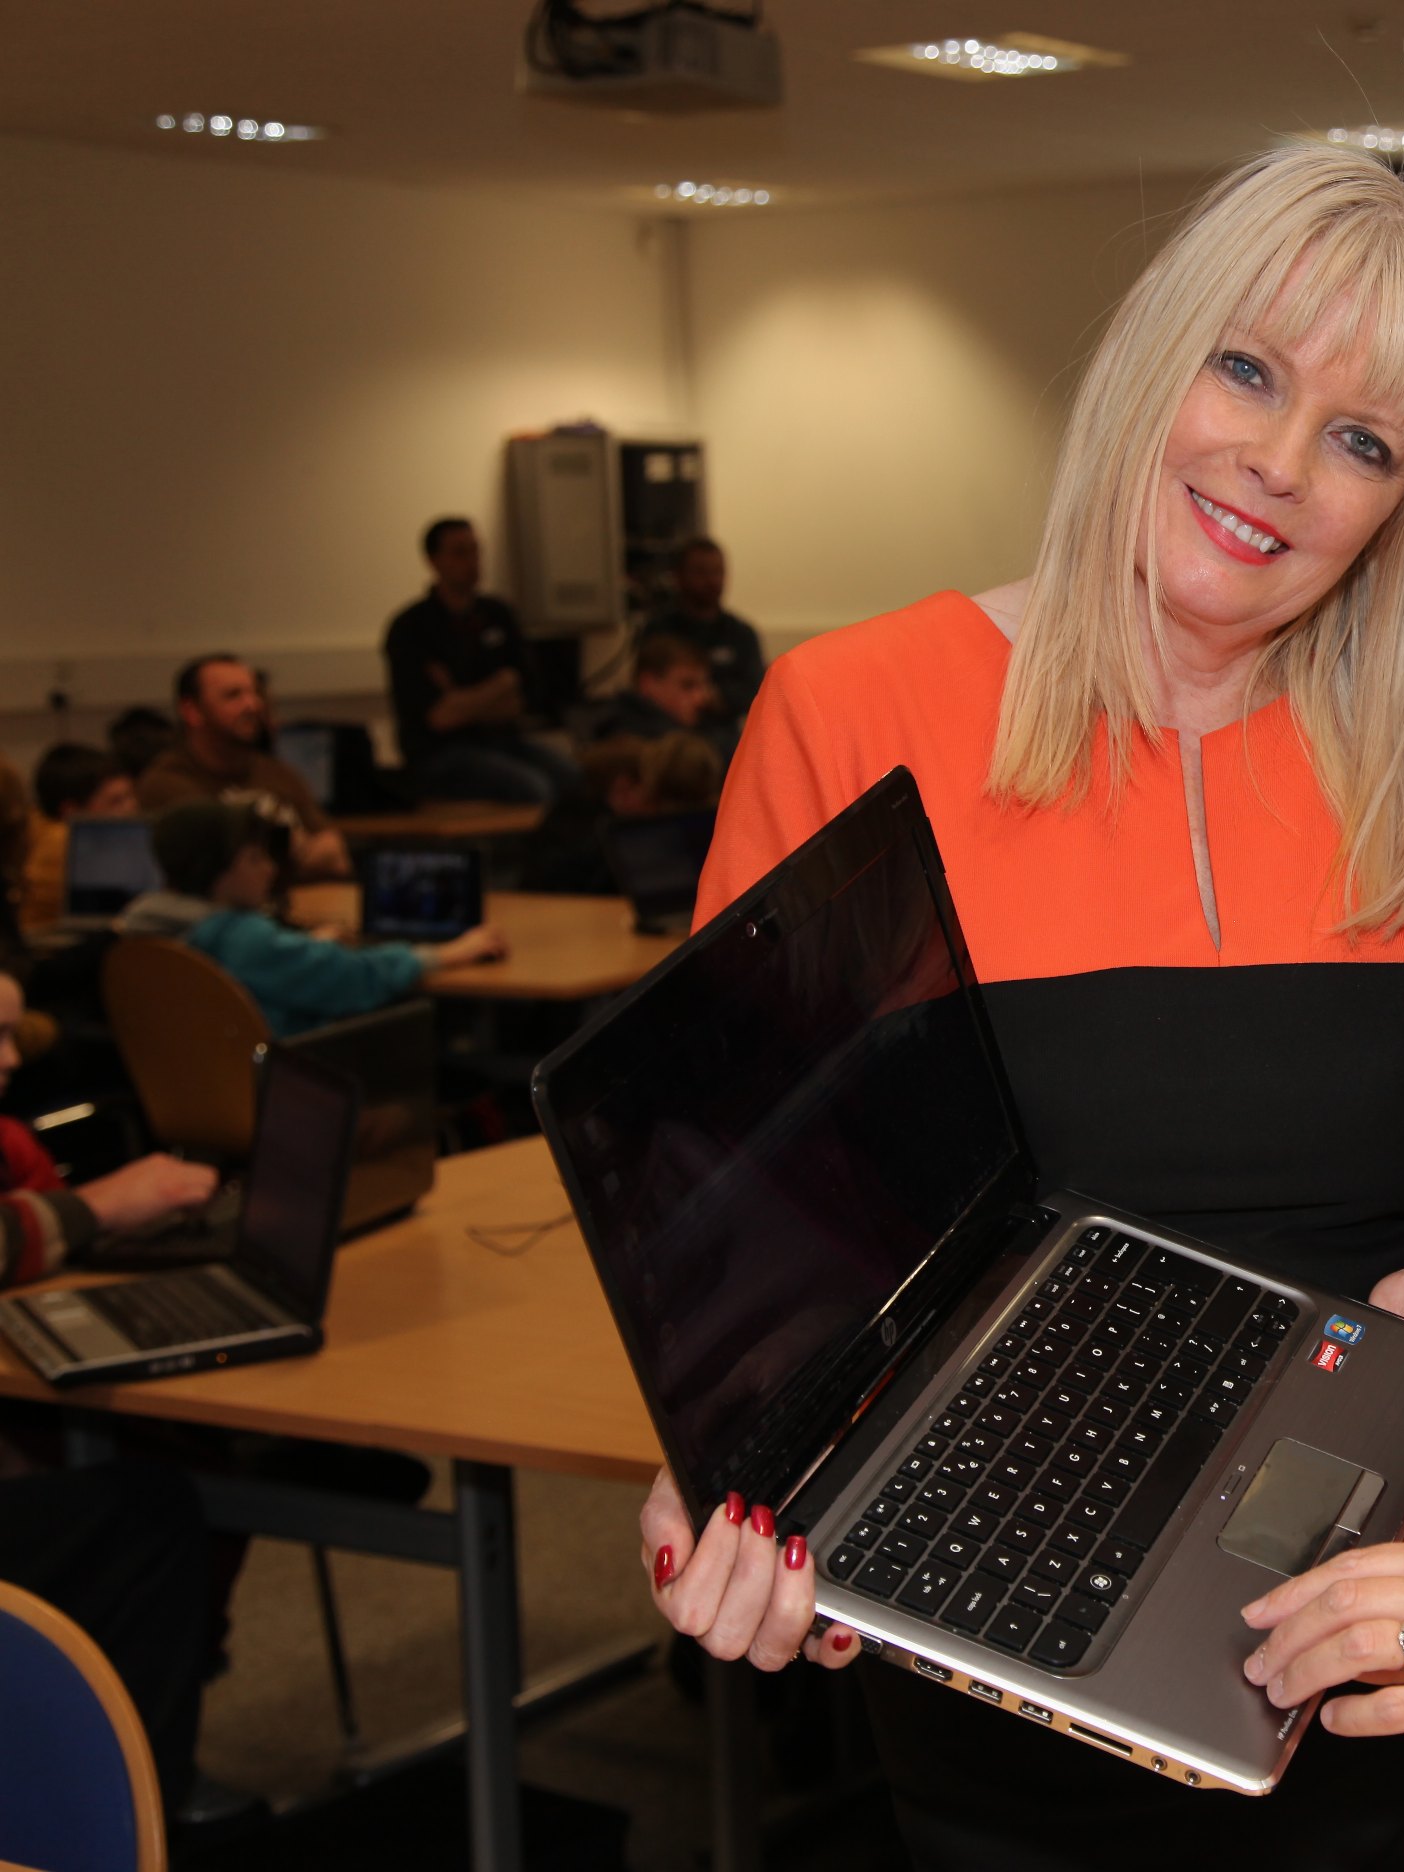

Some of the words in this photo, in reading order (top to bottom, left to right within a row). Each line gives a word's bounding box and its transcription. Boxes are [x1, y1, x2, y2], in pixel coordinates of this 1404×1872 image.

[1349, 1328, 1361, 1342] Windows
[1151, 1410, 1162, 1418] M
[1134, 1433, 1146, 1441] N
[937, 1488, 947, 1496] 3
[1085, 1507, 1096, 1515] C
[968, 1515, 981, 1525] W
[1067, 1533, 1079, 1542] X
[950, 1544, 963, 1552] Q
[1049, 1560, 1061, 1568] Z
